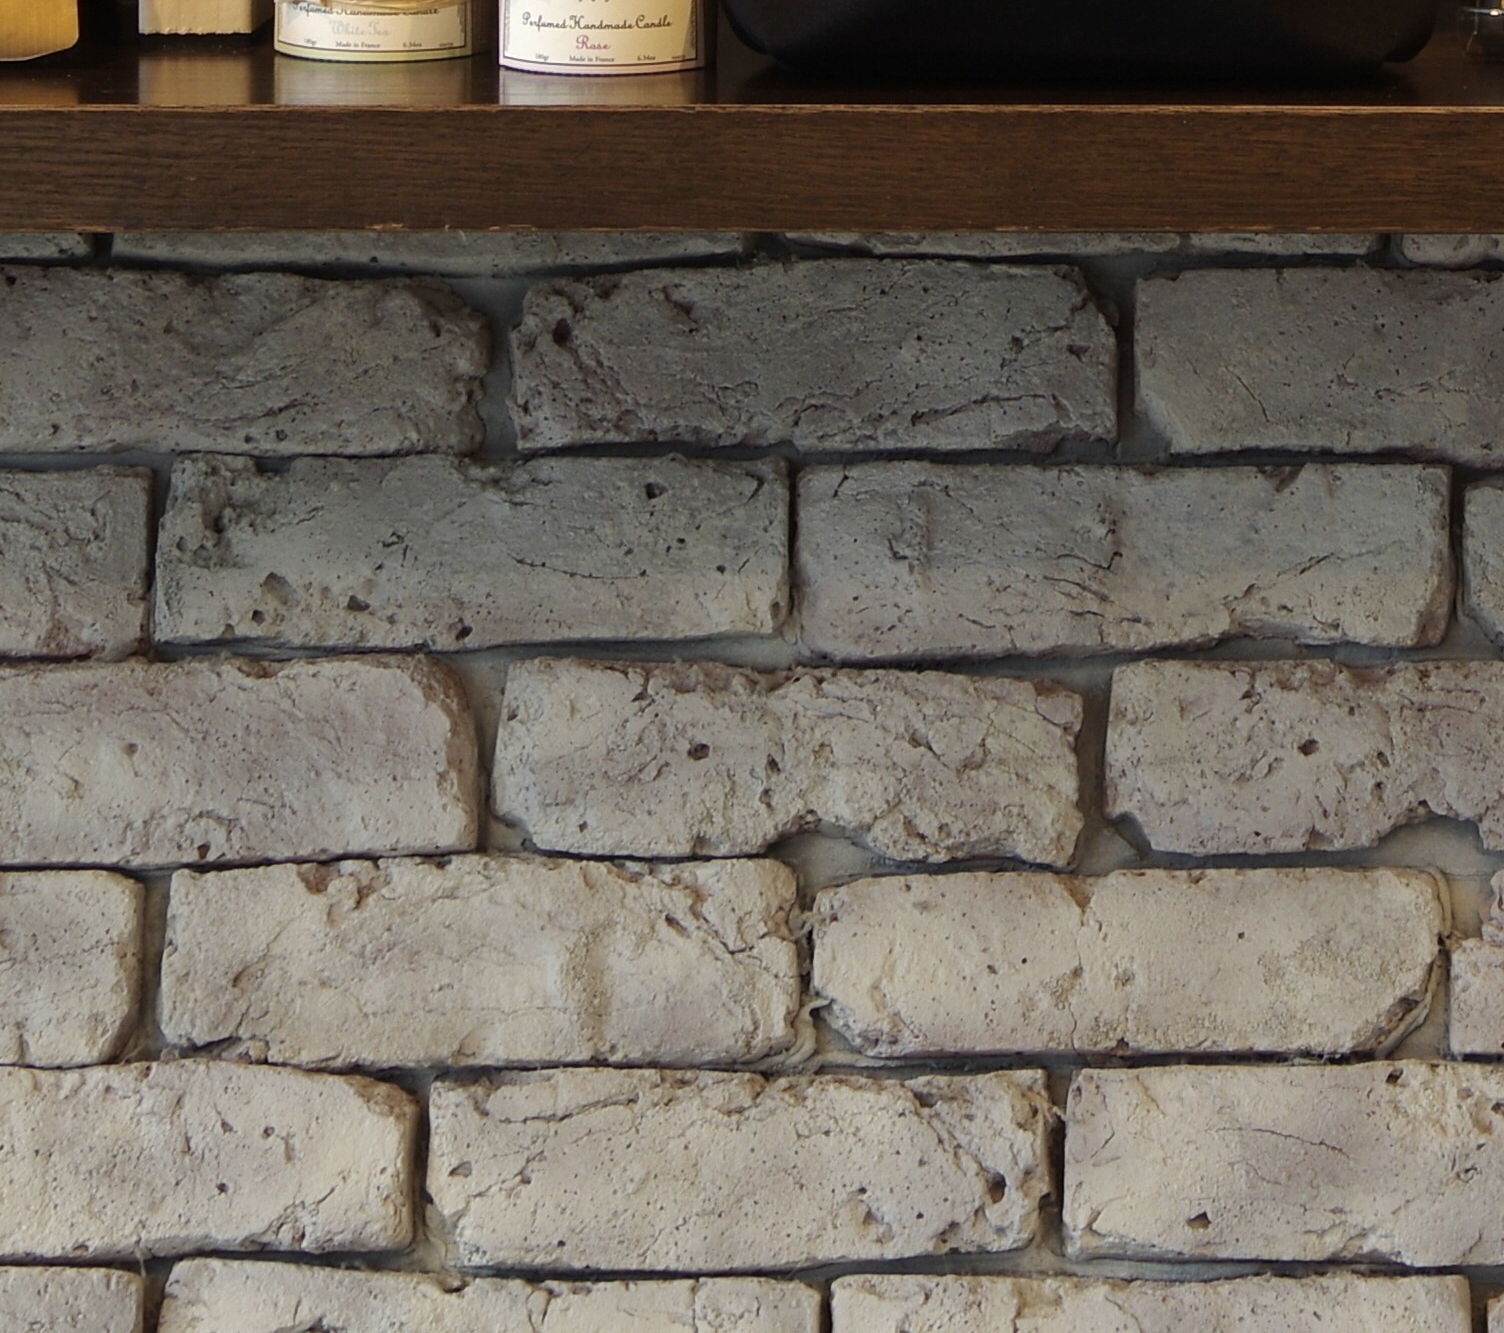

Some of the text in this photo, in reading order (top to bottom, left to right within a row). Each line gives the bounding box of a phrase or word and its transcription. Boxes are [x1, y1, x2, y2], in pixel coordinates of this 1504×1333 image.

[523, 12, 672, 30] Perfumed Handmade Candle
[576, 35, 611, 51] Rose
